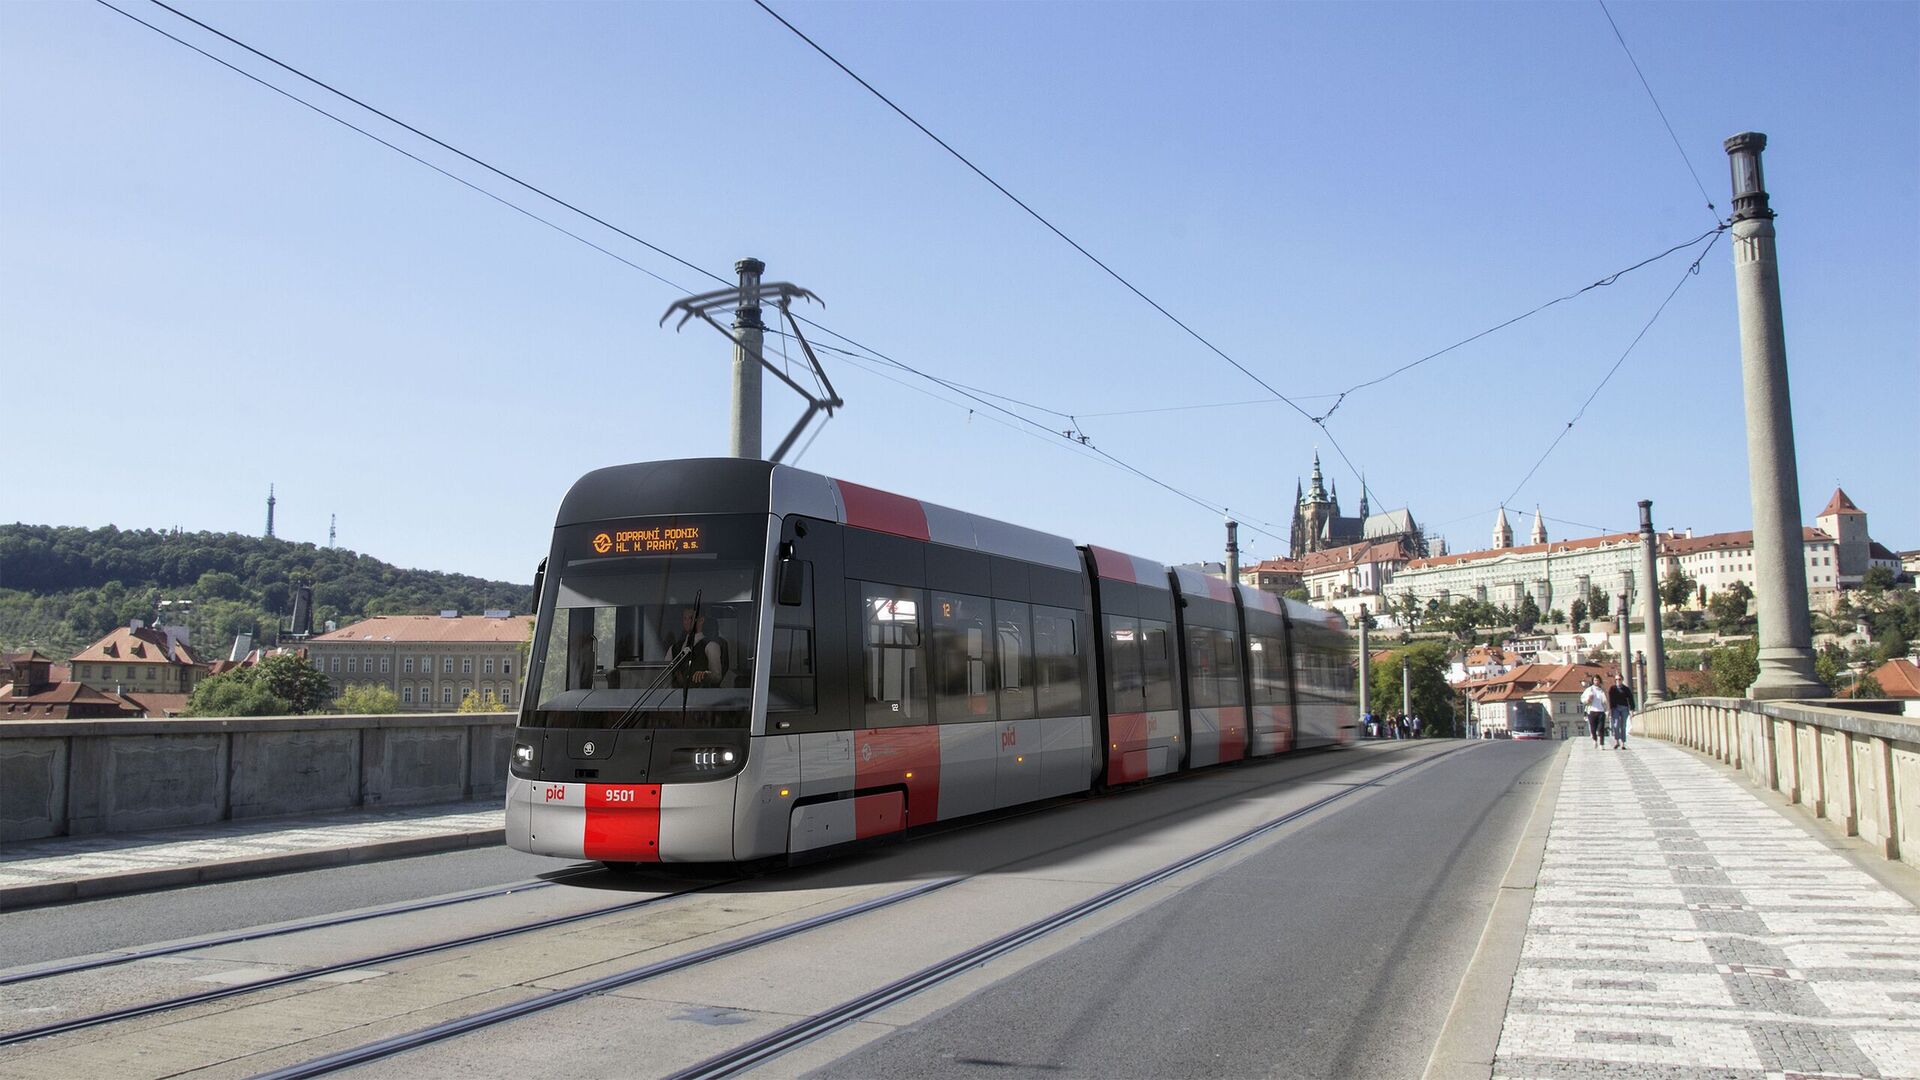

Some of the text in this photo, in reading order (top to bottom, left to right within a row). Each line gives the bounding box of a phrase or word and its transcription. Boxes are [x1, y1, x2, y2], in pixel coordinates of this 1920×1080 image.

[616, 527, 699, 542] DOPRAVNÍ PODNIK
[616, 542, 629, 553] HL.
[646, 540, 679, 551] PRAHY,
[683, 541, 699, 549] a.s.
[943, 603, 951, 617] 12
[1001, 726, 1016, 752] pid
[546, 784, 565, 802] pid
[605, 789, 634, 802] 9501
